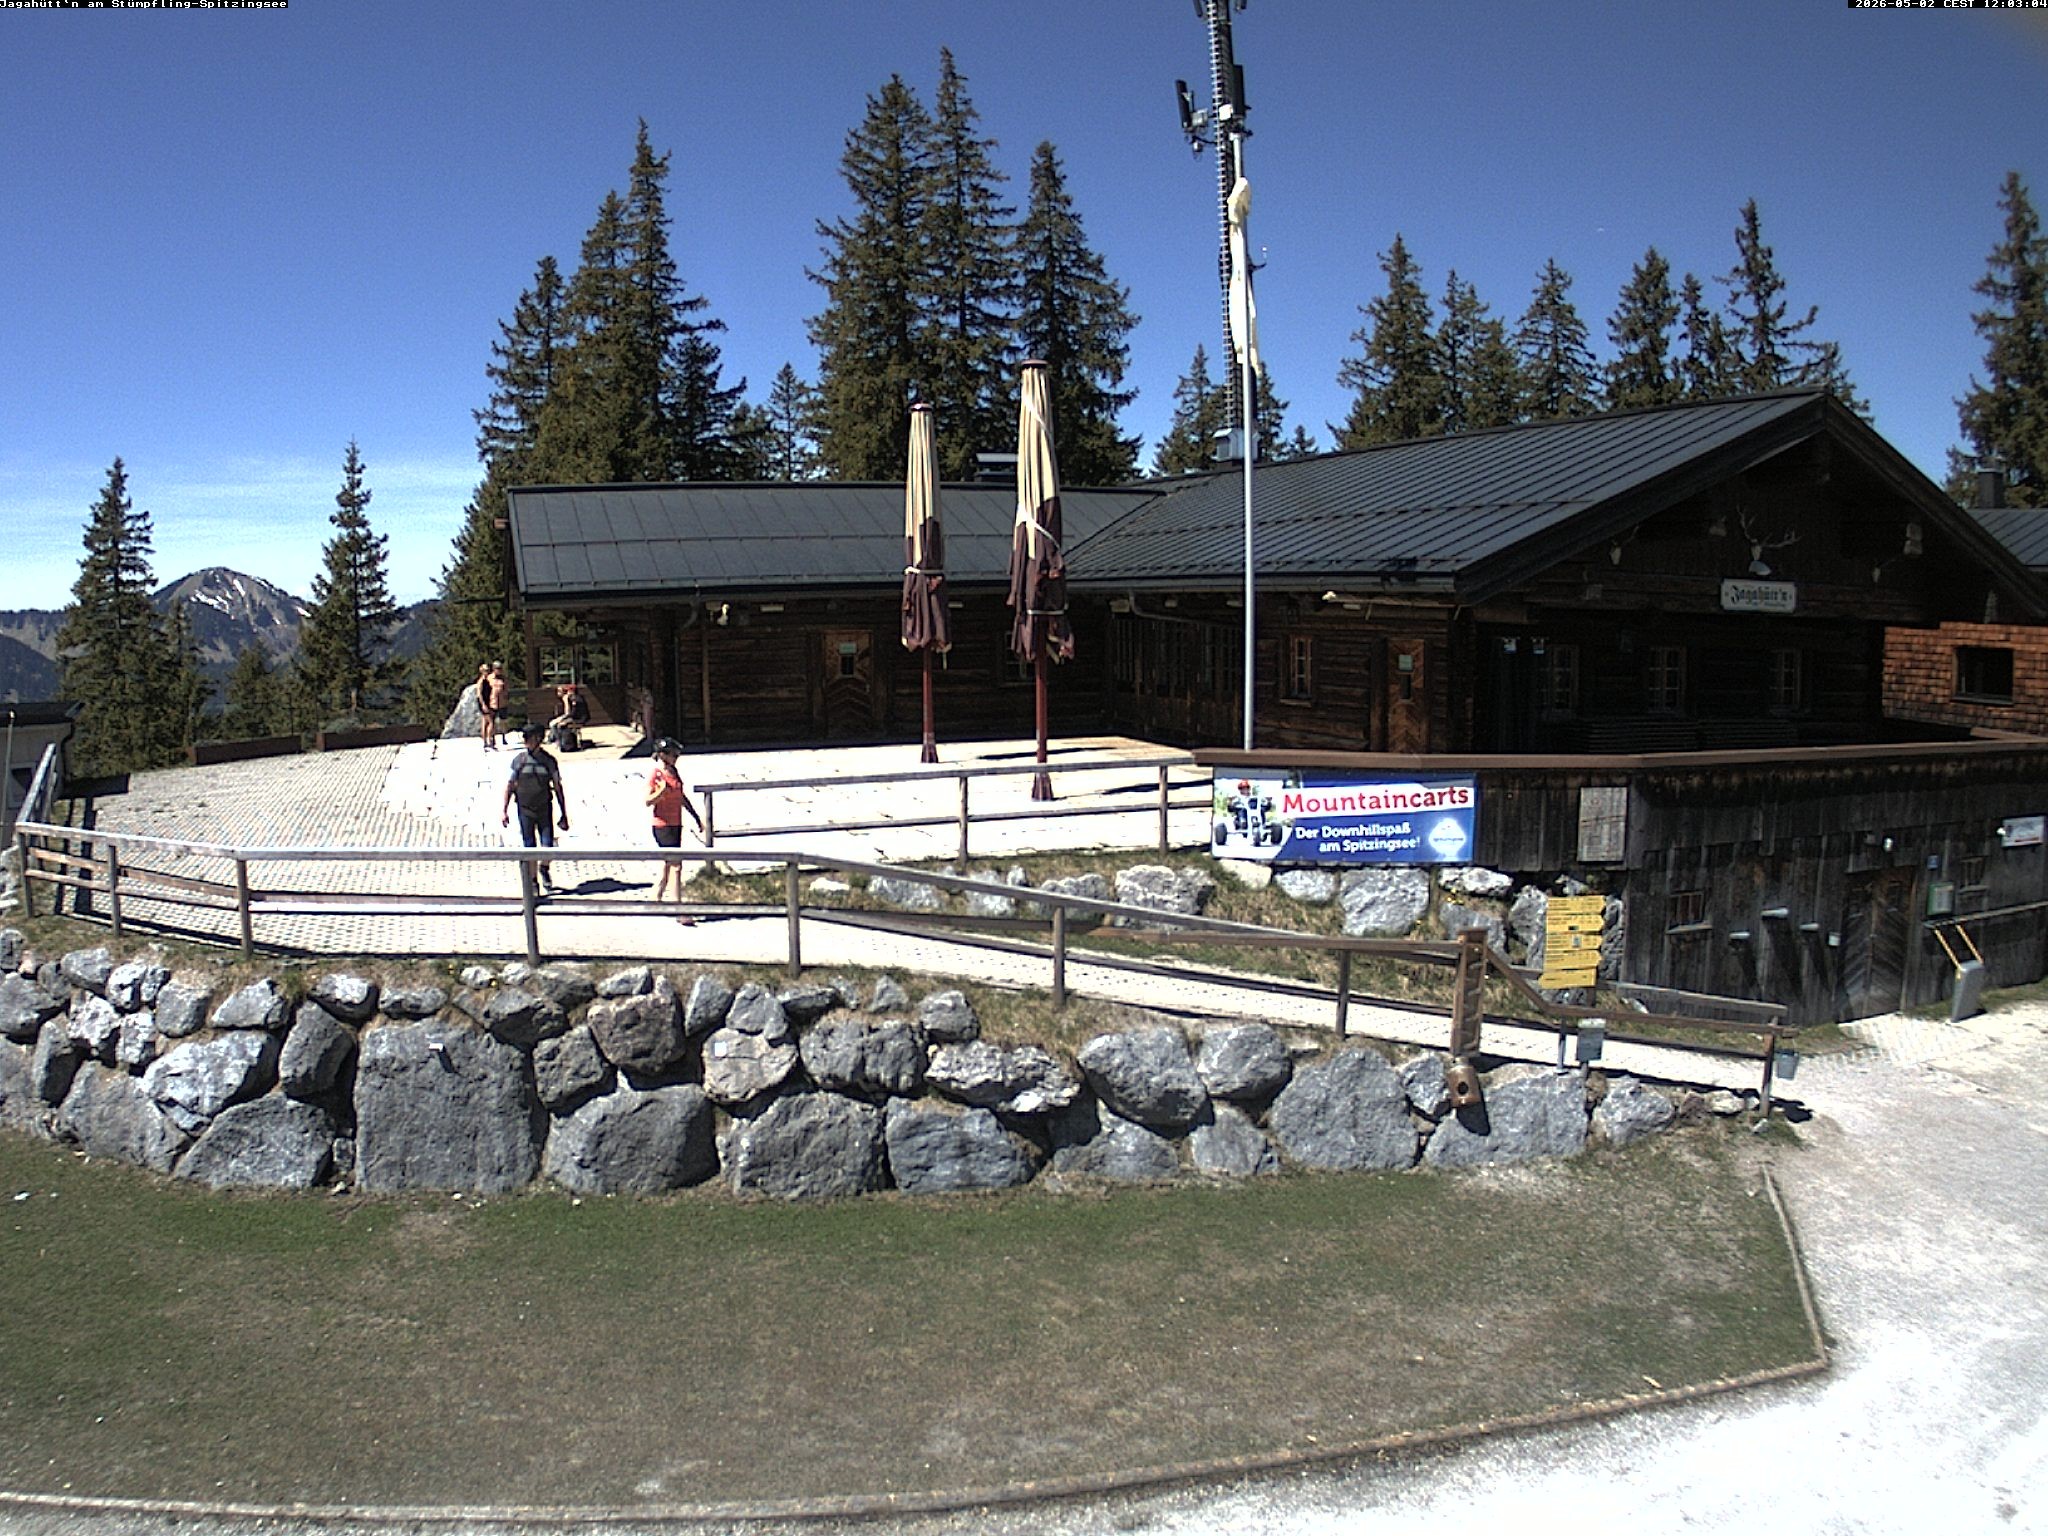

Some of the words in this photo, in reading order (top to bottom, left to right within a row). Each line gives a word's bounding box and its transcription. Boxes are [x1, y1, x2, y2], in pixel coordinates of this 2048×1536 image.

[1282, 786, 1470, 814] Mountaincarts
[1295, 826, 1319, 839] Der
[1321, 821, 1411, 838] Downhillspaß
[1319, 841, 1341, 853] am
[1342, 836, 1421, 854] Spitzingsee!
